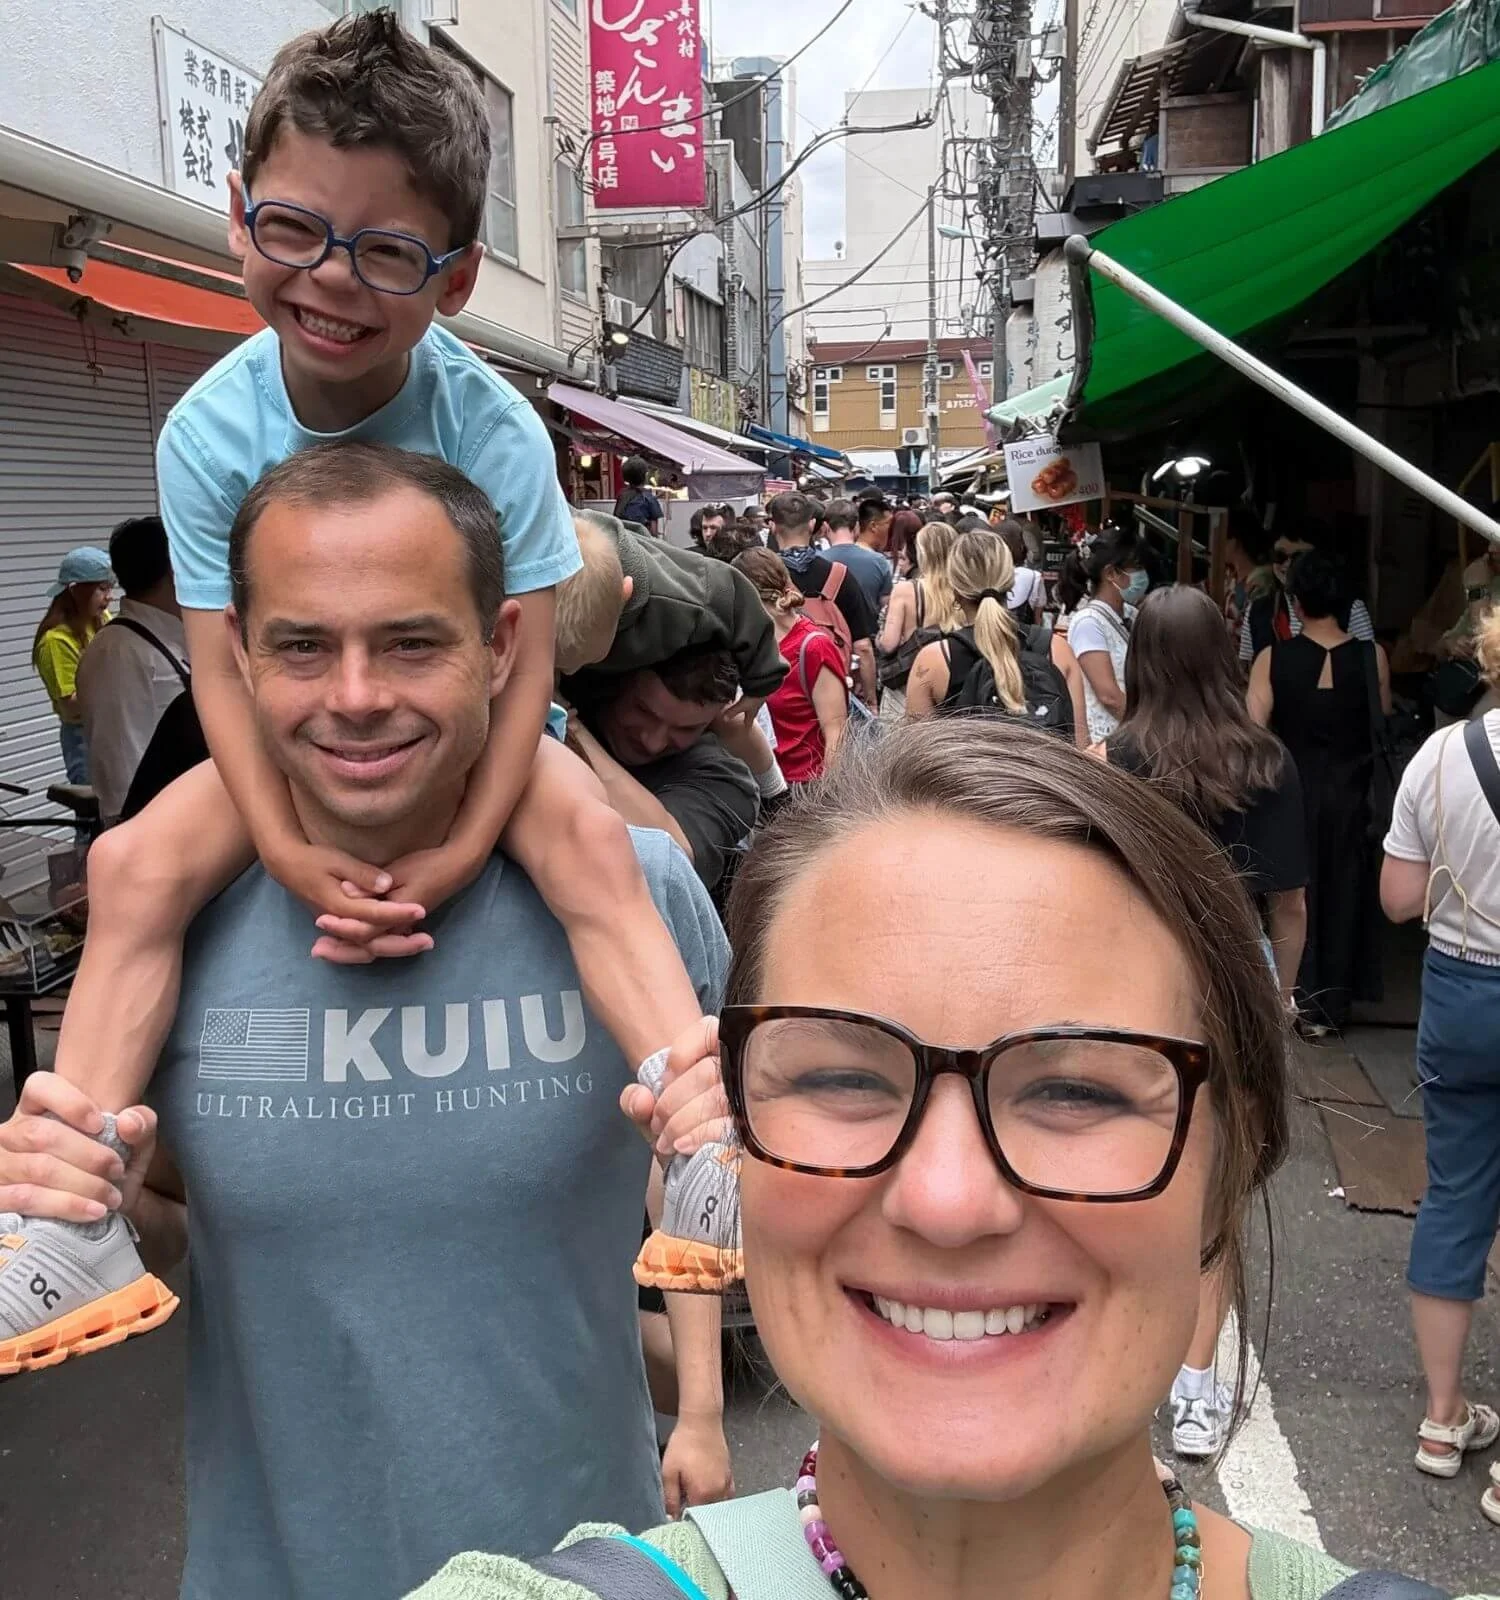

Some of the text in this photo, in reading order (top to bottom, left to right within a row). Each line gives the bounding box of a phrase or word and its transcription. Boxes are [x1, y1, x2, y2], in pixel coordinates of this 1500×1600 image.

[1010, 449, 1034, 461] Rice
[323, 990, 586, 1083] KUIU
[196, 1072, 594, 1120] ULTRALIGHT HUNTING
